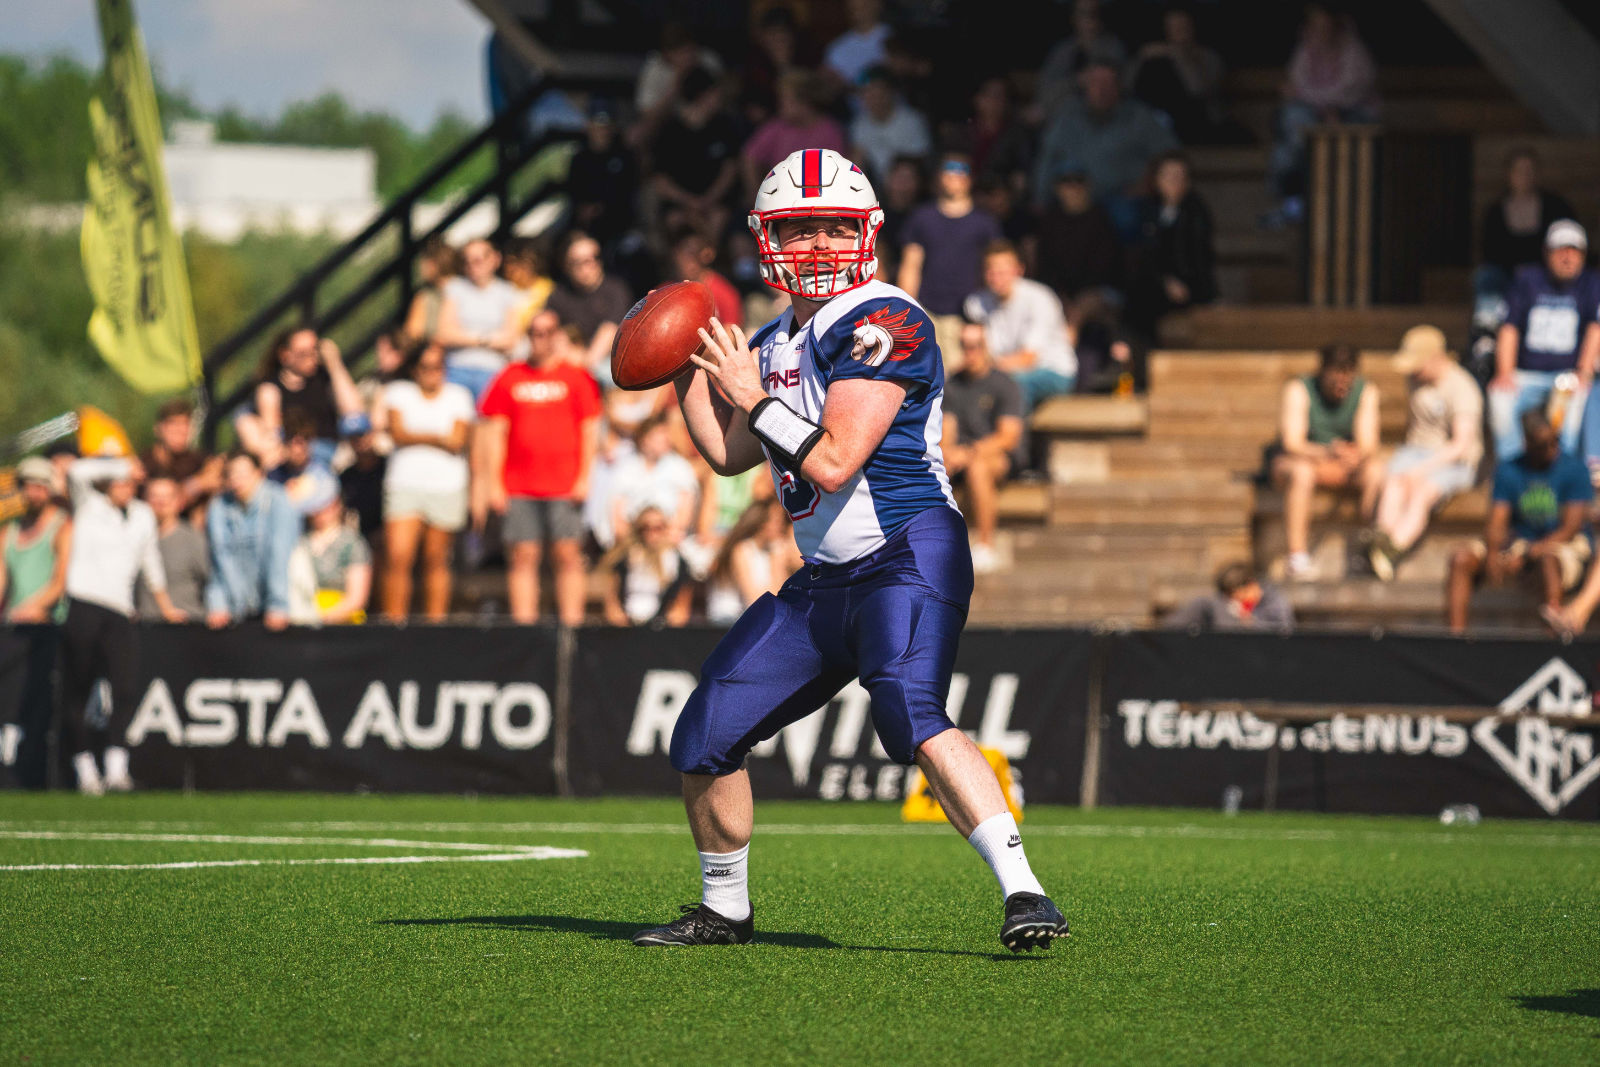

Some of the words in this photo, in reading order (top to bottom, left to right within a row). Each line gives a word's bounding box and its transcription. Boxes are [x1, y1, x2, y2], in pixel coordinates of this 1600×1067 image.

[126, 677, 331, 749] ASTA
[343, 680, 552, 750] AUTO
[709, 867, 733, 877] NIKE
